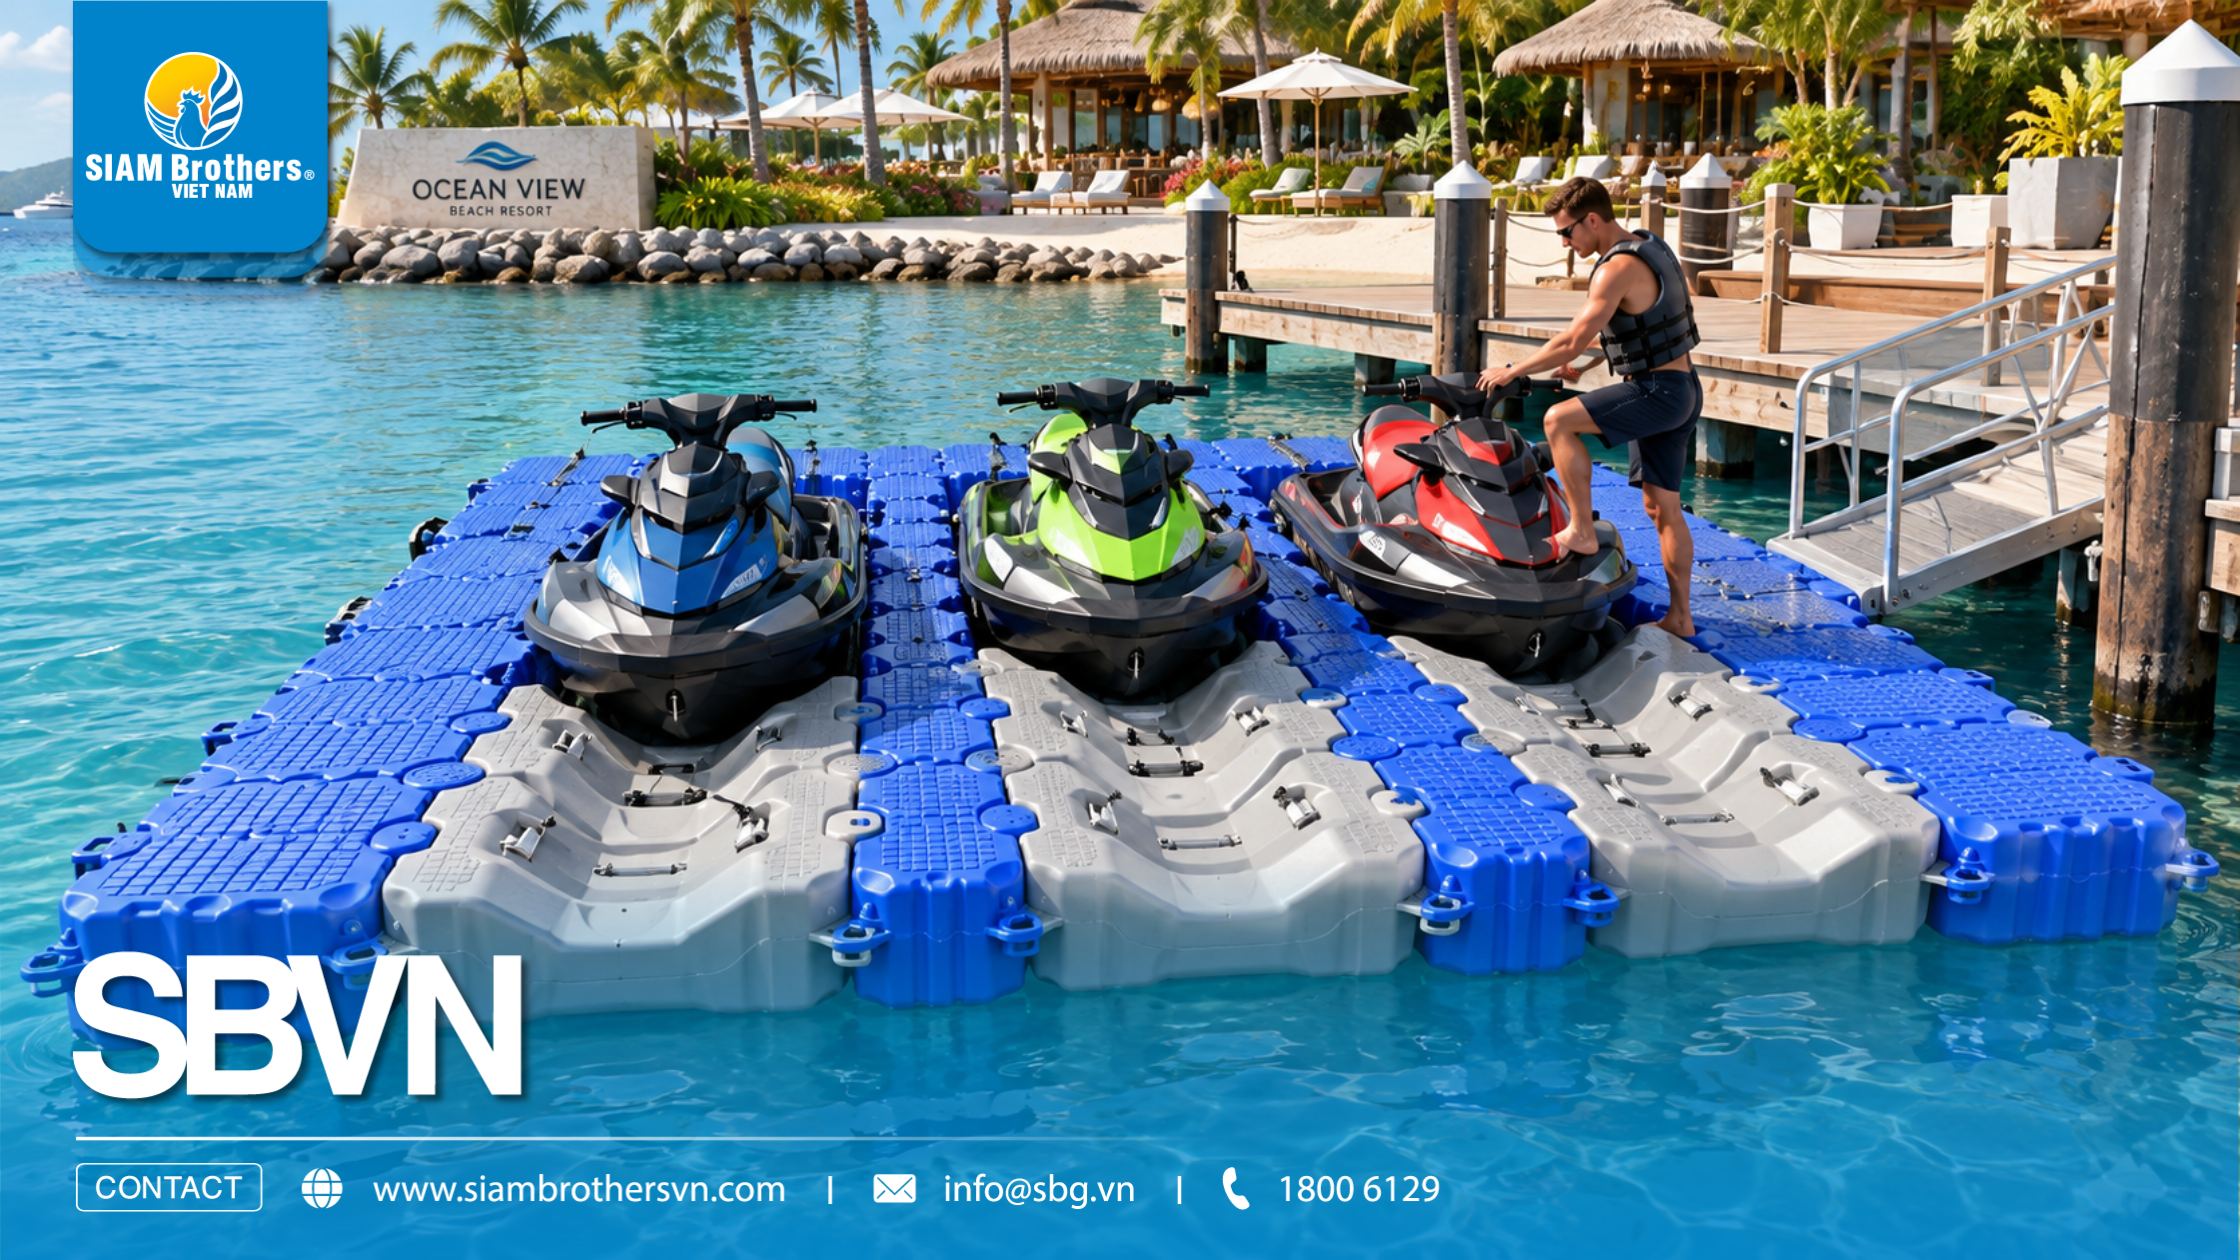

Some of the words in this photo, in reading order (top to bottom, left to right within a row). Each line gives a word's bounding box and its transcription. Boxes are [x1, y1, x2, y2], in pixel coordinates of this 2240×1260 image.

[412, 178, 506, 201] OCEAN
[516, 178, 586, 200] VIEW
[449, 205, 495, 217] BEACH
[500, 205, 552, 217] RESORT
